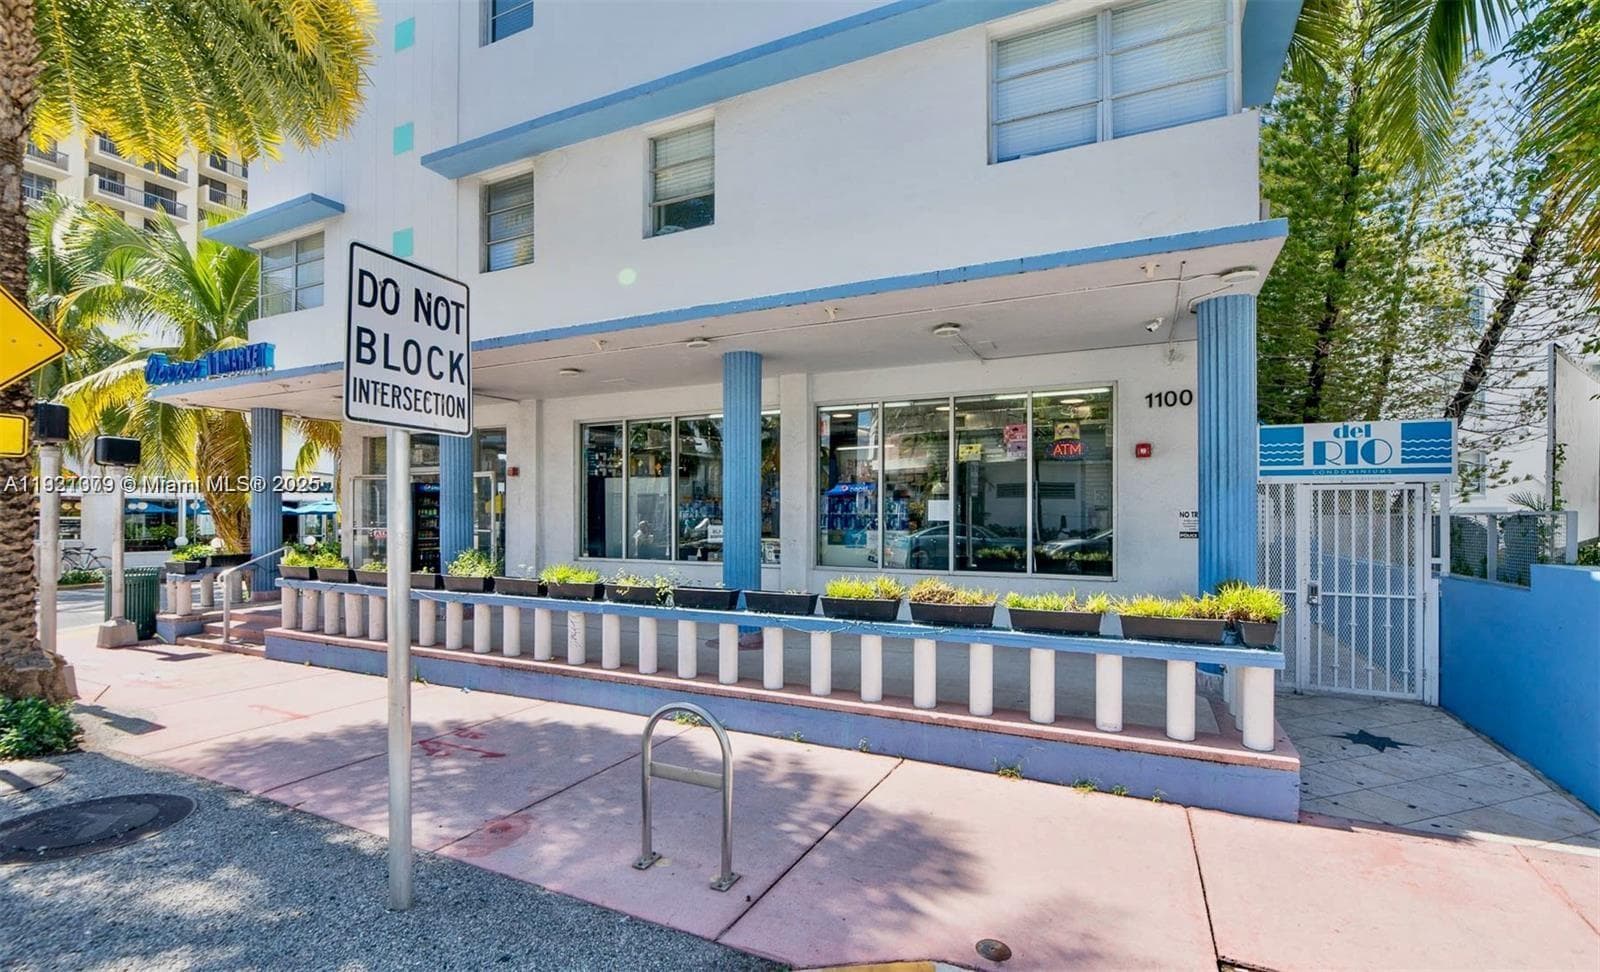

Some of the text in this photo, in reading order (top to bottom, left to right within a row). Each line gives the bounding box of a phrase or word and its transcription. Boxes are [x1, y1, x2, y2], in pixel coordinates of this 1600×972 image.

[358, 268, 464, 335] DO NOT
[356, 326, 465, 385] BLOCK
[352, 377, 465, 419] INTERSECTION
[1145, 389, 1193, 408] 1100
[1333, 423, 1371, 439] del
[1053, 444, 1082, 456] ATM
[1313, 439, 1393, 466] RIO
